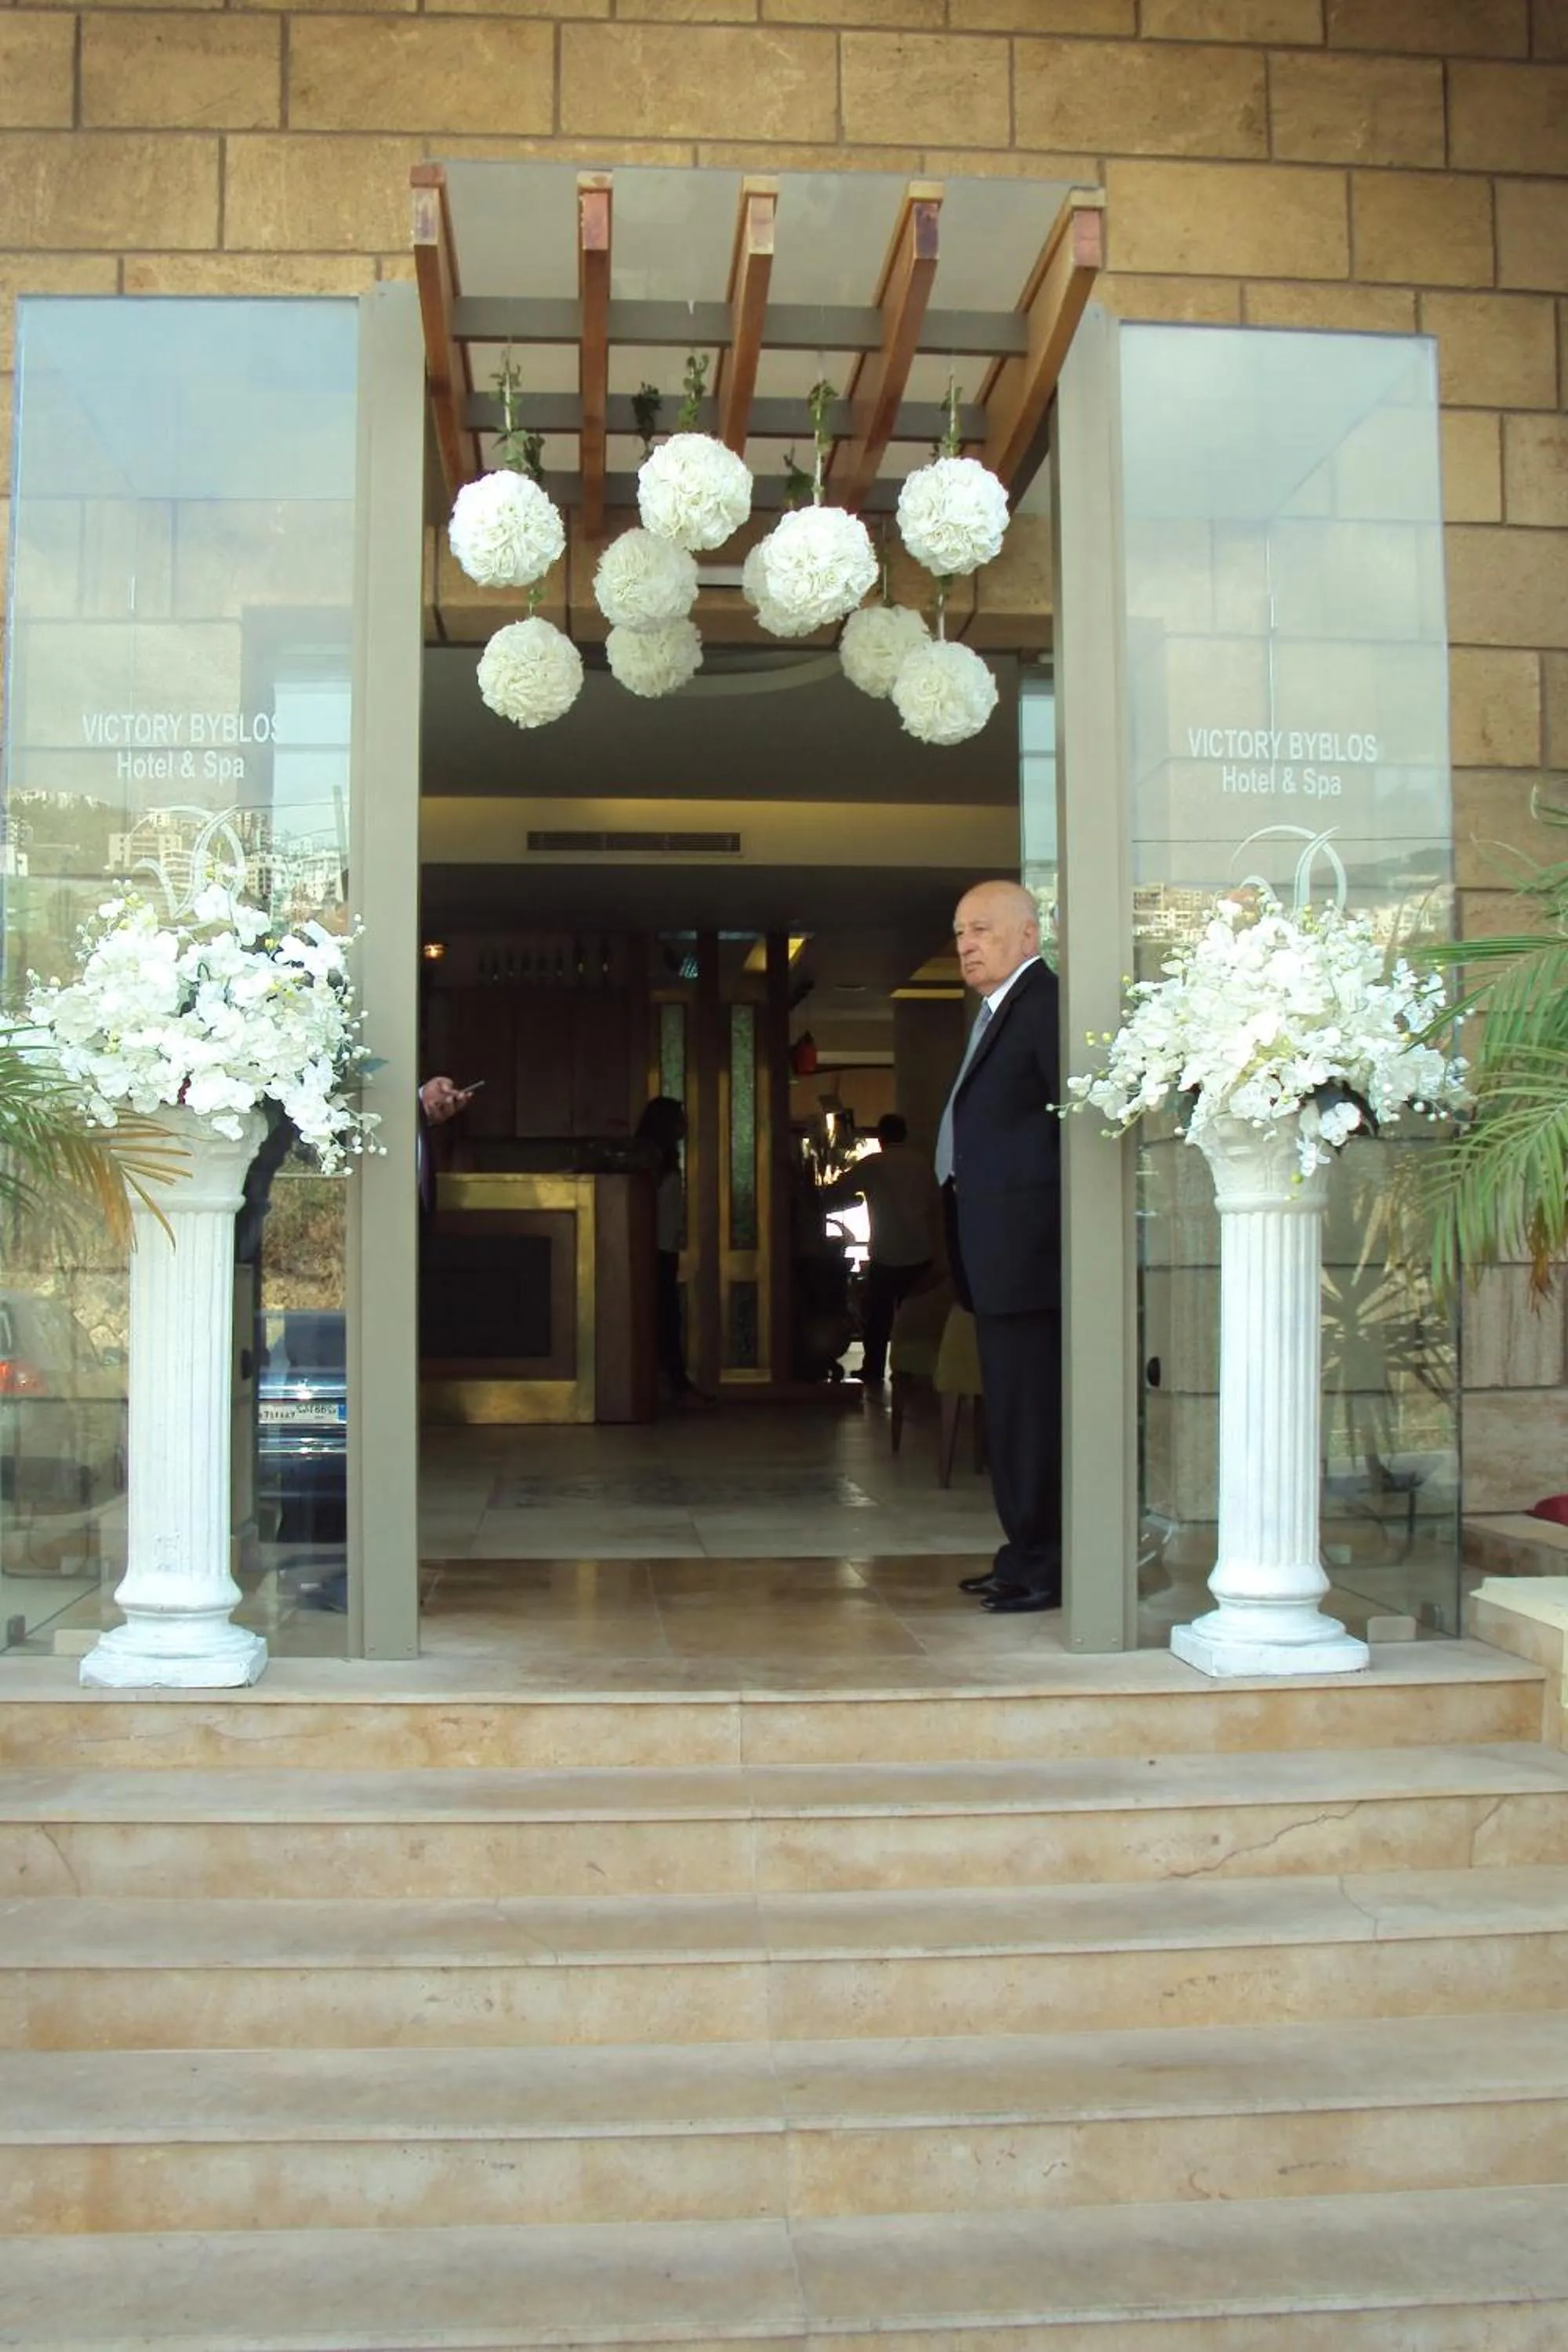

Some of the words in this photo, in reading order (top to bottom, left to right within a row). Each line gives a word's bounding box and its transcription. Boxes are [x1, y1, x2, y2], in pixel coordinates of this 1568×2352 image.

[82, 713, 183, 745] VICTORY
[1188, 728, 1283, 760] VICTORY
[1289, 731, 1377, 762] BYBLOS
[117, 750, 174, 779] Hotel
[180, 751, 195, 779] &
[203, 750, 245, 783] Spa
[1222, 765, 1275, 794] Hotel
[1282, 768, 1297, 794] &
[1303, 768, 1342, 799] Spa
